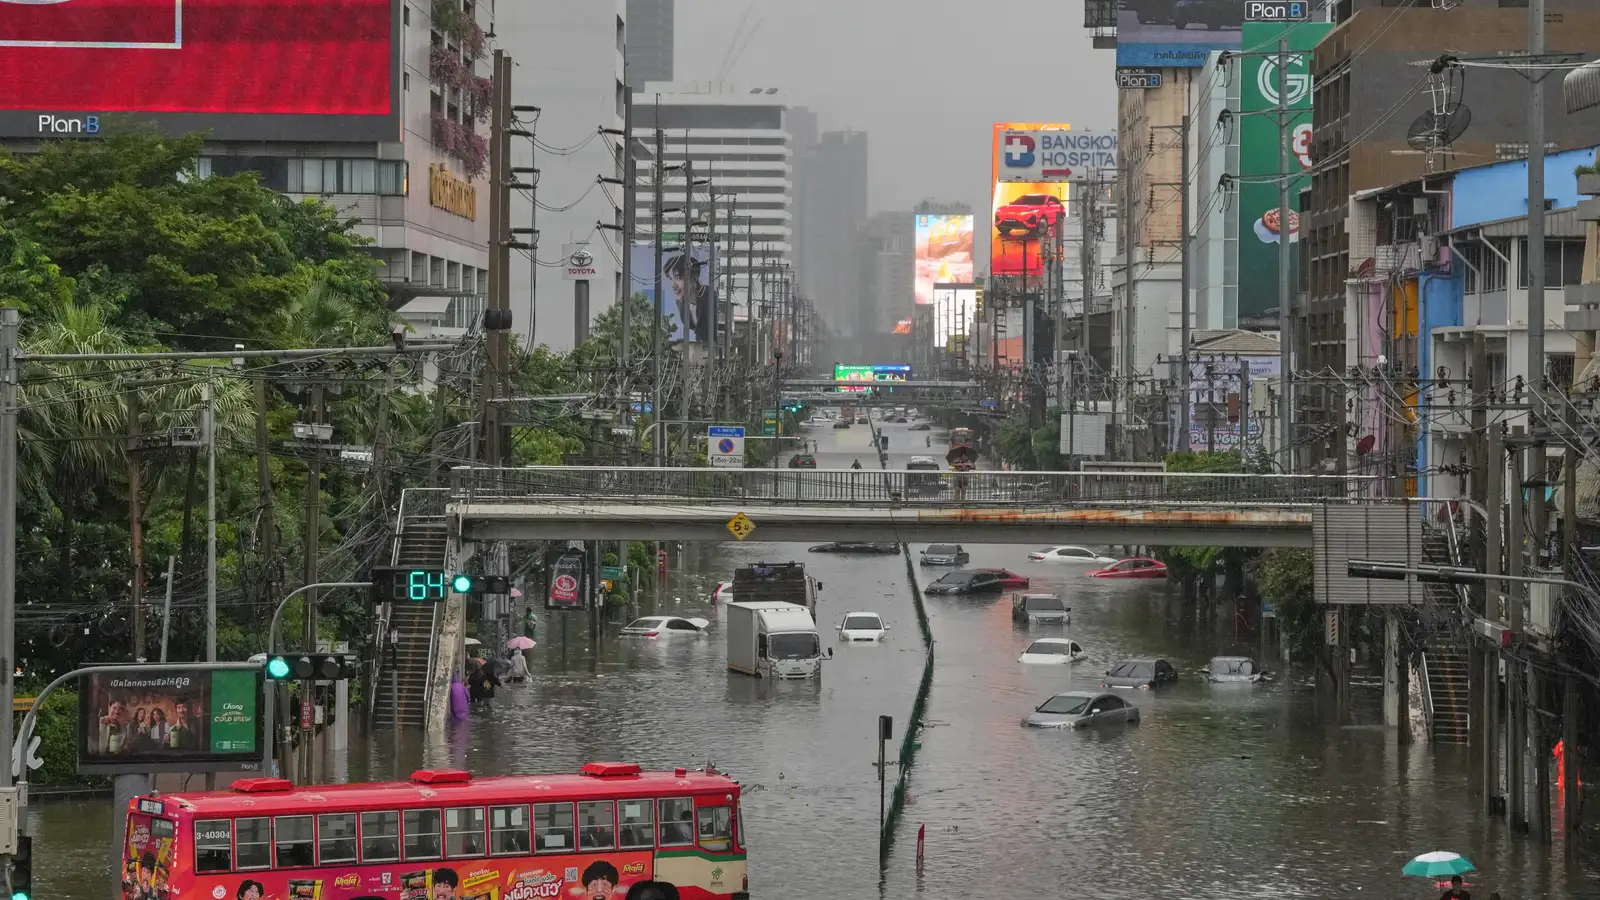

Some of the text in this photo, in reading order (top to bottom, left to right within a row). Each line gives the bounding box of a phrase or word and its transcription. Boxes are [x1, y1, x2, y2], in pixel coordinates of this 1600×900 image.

[1251, 3, 1286, 17] Plan
[1042, 152, 1116, 167] HOSPITA
[734, 521, 742, 532] 5
[410, 571, 443, 600] 64
[223, 703, 244, 711] Chang
[196, 831, 231, 840] 3-40304
